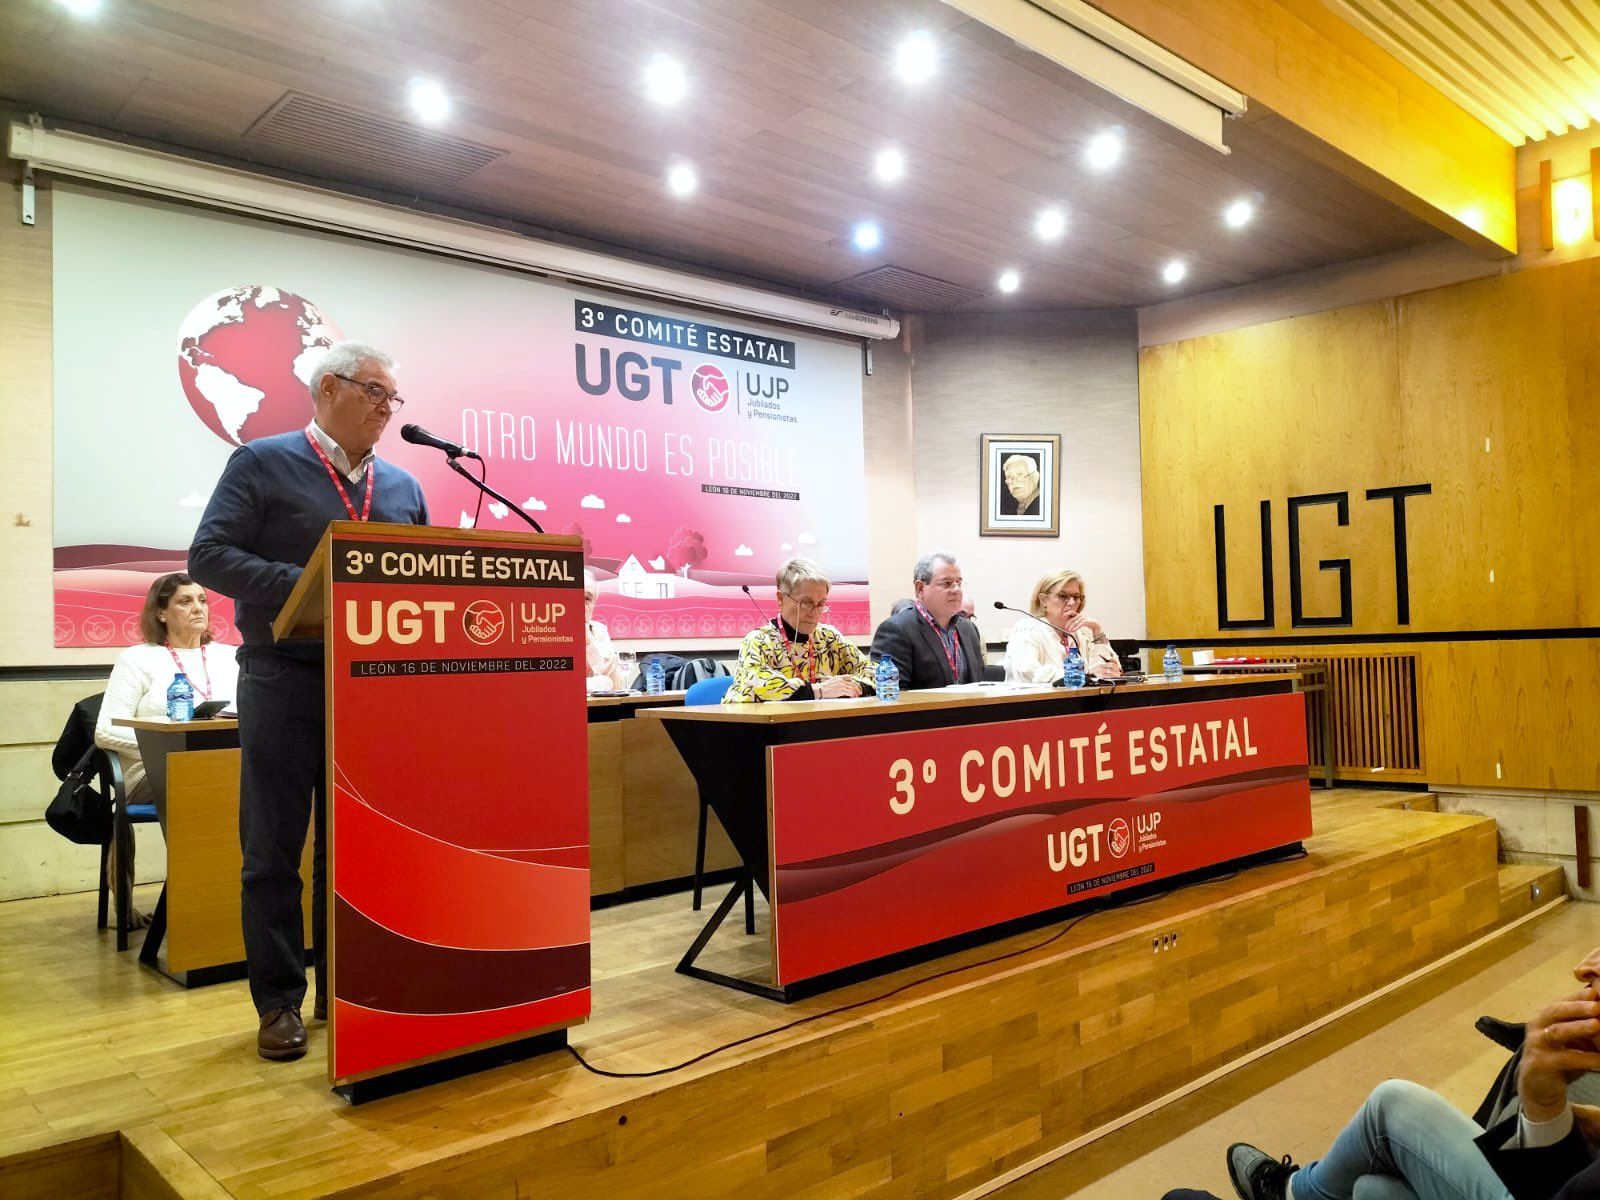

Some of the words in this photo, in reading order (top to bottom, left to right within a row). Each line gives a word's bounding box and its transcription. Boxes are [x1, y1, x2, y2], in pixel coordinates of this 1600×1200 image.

[614, 313, 699, 348] COMITÉ
[707, 331, 791, 365] ESTATAL
[575, 342, 682, 406] UGT
[746, 372, 790, 400] UJP
[753, 409, 798, 423] Pensionistas
[462, 408, 536, 461] OTRO
[555, 419, 648, 472] MUNDO
[664, 432, 694, 476] ES
[708, 437, 799, 486] POSIBLE
[380, 550, 476, 578] COMITÉ
[481, 556, 575, 582] ESTATAL
[1214, 483, 1432, 631] UGT
[345, 600, 455, 646] UGT
[520, 602, 566, 624] UJP
[521, 624, 557, 634] Jubilados
[521, 636, 527, 645] y
[528, 634, 574, 644] Pensionistas
[361, 661, 396, 675] LEÓN
[401, 663, 416, 674] 16
[421, 662, 437, 673] DE
[442, 660, 511, 672] NOVIEMBRE
[515, 659, 536, 671] DEL
[539, 659, 568, 670] 2022
[959, 721, 1114, 803] COMITÉ
[1128, 716, 1258, 776] ESTATAL
[1136, 811, 1161, 834] UJP
[1047, 823, 1104, 872] UGT
